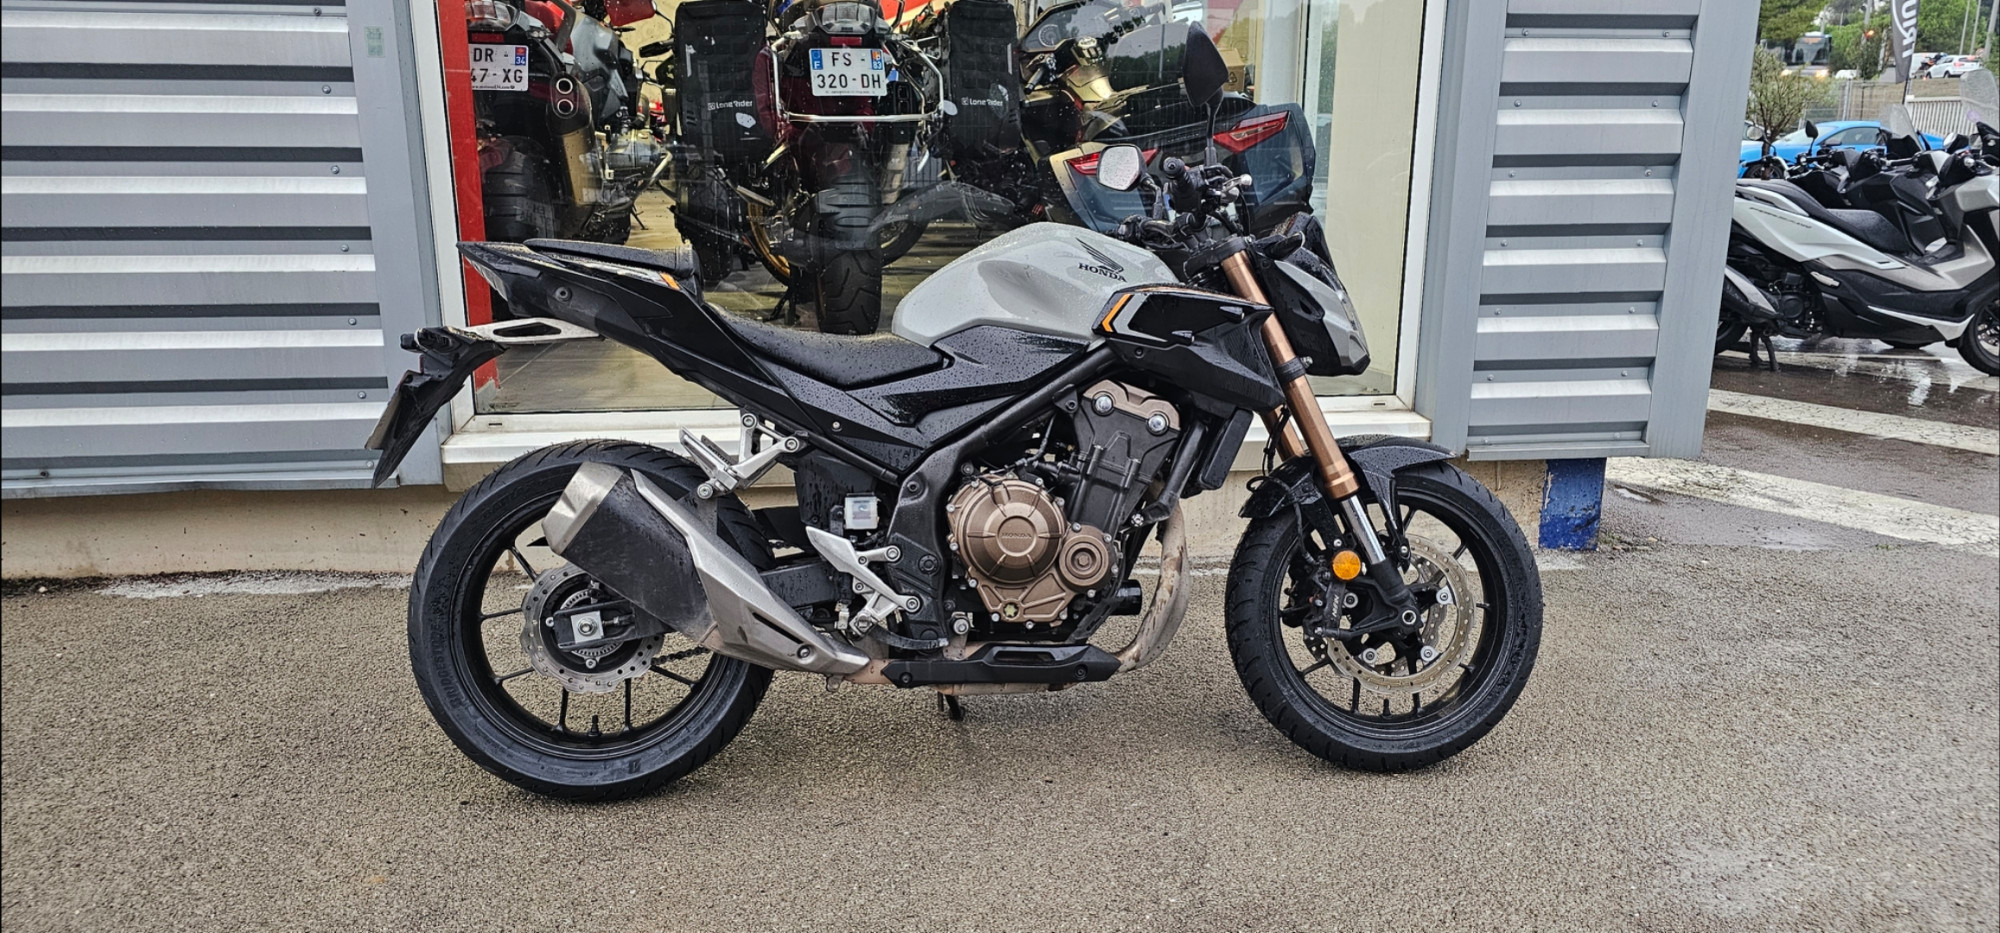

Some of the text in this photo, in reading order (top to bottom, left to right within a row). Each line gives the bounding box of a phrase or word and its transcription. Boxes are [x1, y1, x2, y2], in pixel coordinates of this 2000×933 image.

[473, 48, 494, 62] DR
[516, 56, 526, 65] 34
[832, 52, 852, 67] FS
[814, 61, 821, 69] F
[873, 61, 883, 69] 83
[1079, 262, 1127, 283] HONDA
